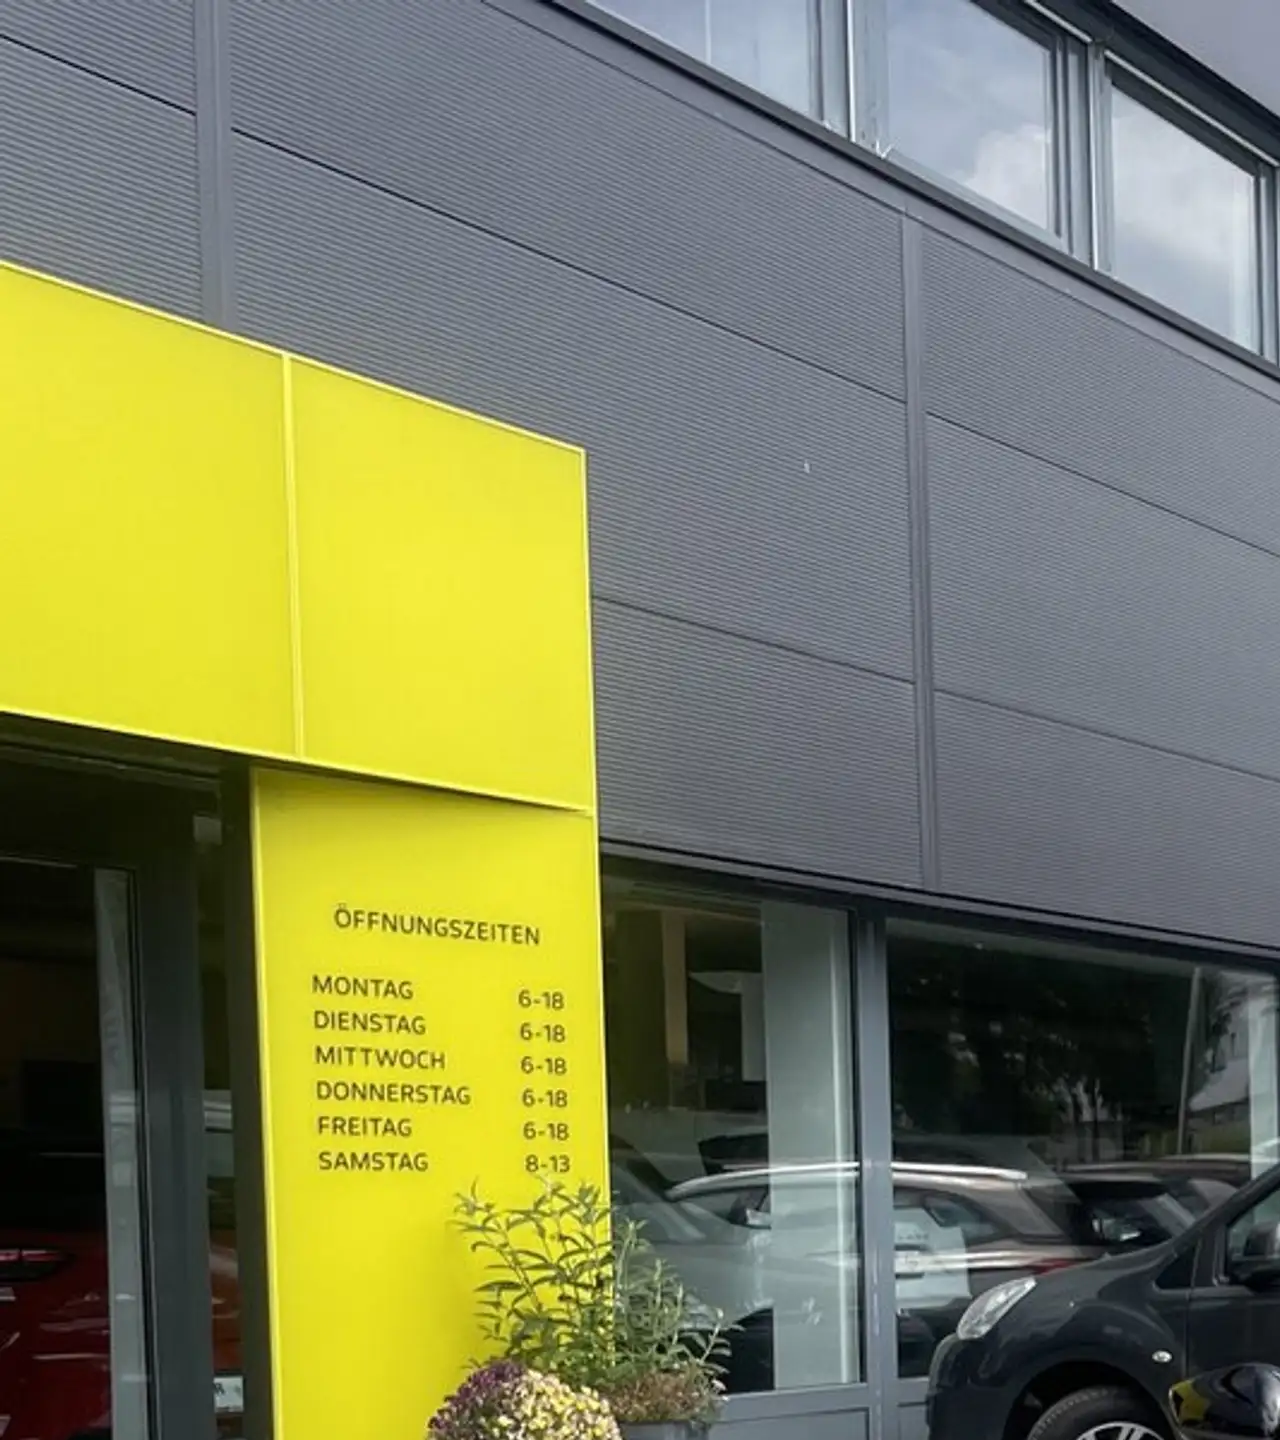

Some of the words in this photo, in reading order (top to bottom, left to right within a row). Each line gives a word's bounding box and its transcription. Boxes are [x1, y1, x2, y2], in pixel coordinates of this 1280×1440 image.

[333, 903, 540, 946] ÖFFNUNGSZEITEN
[312, 974, 414, 1000] MONTAG
[518, 989, 565, 1010] 6-18
[313, 1009, 426, 1036] DIENSTAG
[519, 1022, 566, 1043] 6-18
[315, 1045, 445, 1070] MITTWOCH
[520, 1056, 567, 1076] 6-18
[316, 1080, 471, 1106] DONNERSTAG
[522, 1088, 568, 1108] 6-18
[317, 1115, 412, 1137] FREITAG
[523, 1122, 570, 1141] 6-18
[318, 1151, 429, 1172] SAMSTAG
[525, 1154, 571, 1173] 8-13
